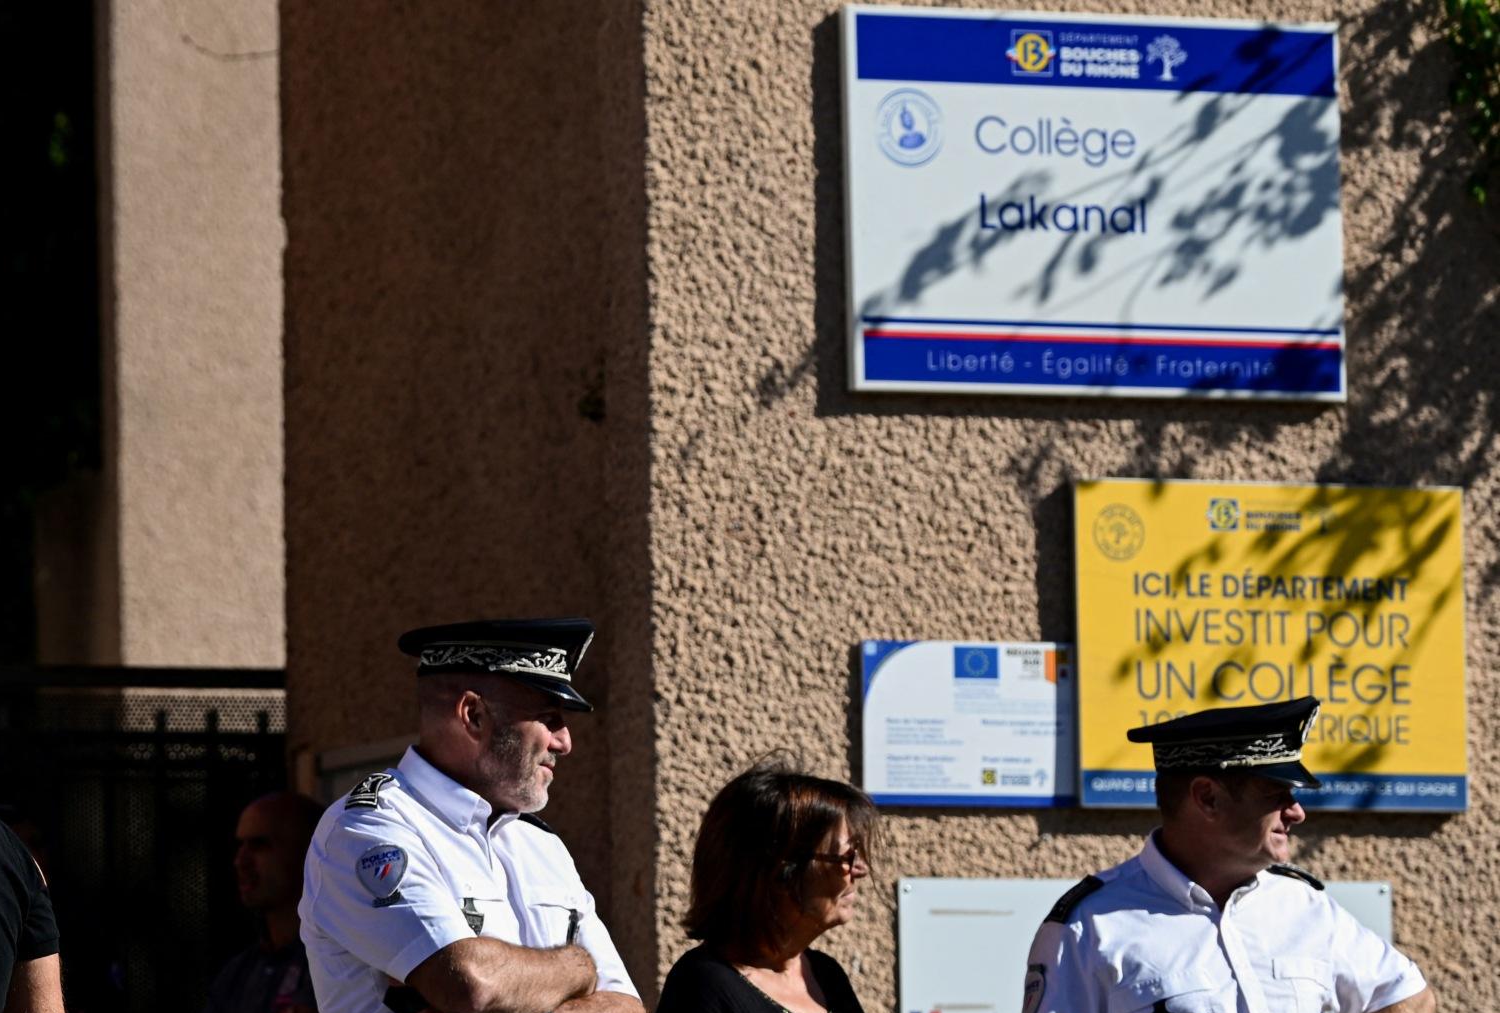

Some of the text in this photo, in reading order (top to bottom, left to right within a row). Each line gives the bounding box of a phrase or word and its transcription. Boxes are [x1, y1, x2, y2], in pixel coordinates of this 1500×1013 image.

[1060, 46, 1140, 63] BOUCHES
[1060, 62, 1083, 77] DU
[975, 115, 1136, 168] Collège
[980, 192, 1147, 234] Lakanal
[926, 350, 1015, 374] Liberté
[1042, 348, 1129, 379] Égalité
[1156, 354, 1276, 378] Fraternité
[1133, 568, 1410, 601] ICI, LE DÉPARTEMENT
[1135, 607, 1411, 649] INVESTIT POUR
[1136, 654, 1412, 706] UN COLLÈGE
[1306, 714, 1411, 746] RIQUE
[1091, 777, 1134, 792] QUAND
[1135, 778, 1149, 793] LE
[1334, 781, 1393, 796] PROVECE
[1395, 781, 1415, 797] QUI
[1417, 781, 1458, 797] GAGNE
[362, 849, 400, 866] POLICE
